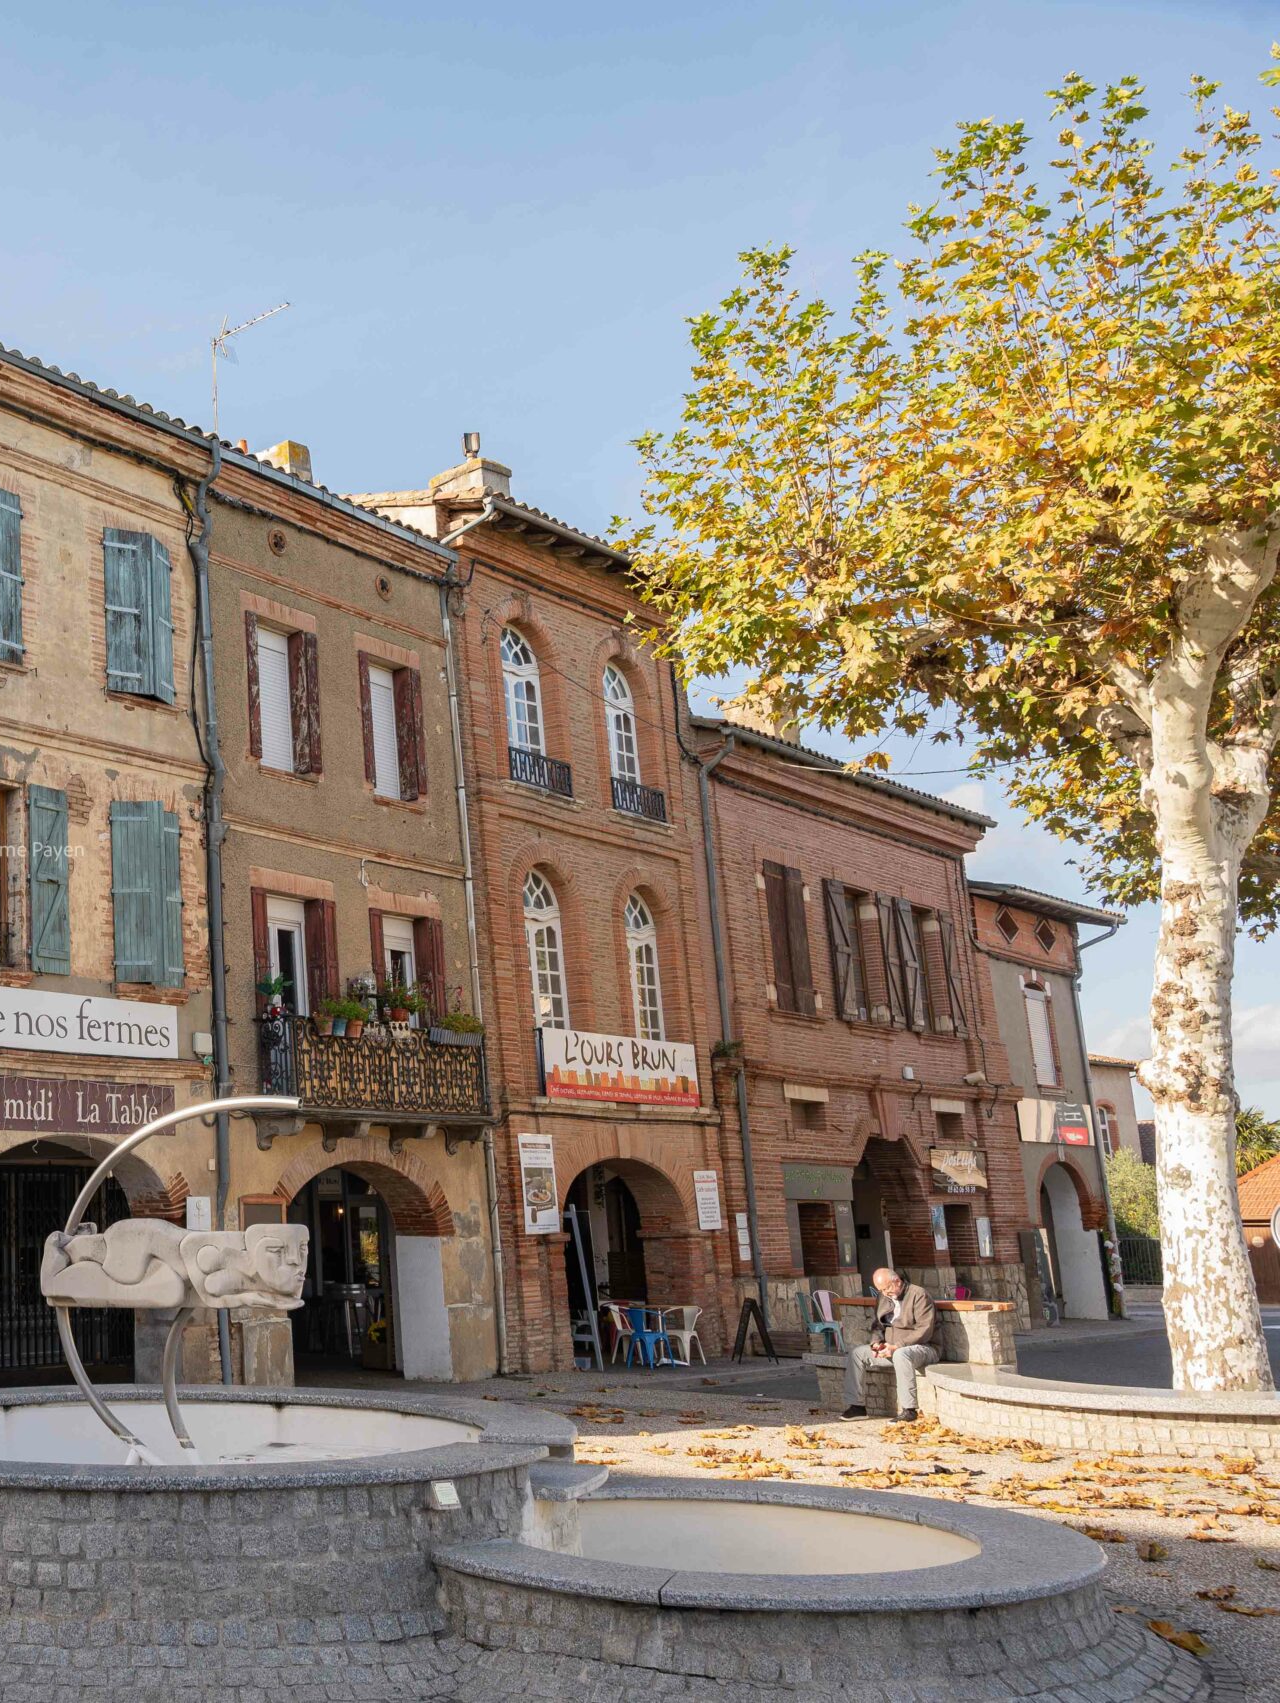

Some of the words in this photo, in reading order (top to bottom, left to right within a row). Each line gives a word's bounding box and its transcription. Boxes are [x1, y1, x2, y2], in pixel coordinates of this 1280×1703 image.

[13, 1010, 68, 1039] nos
[75, 998, 170, 1048] fermes
[564, 1032, 624, 1068] L'OURS
[631, 1039, 676, 1072] BRUN
[5, 1088, 54, 1121] midi
[76, 1091, 100, 1124] La
[105, 1093, 158, 1125] Table
